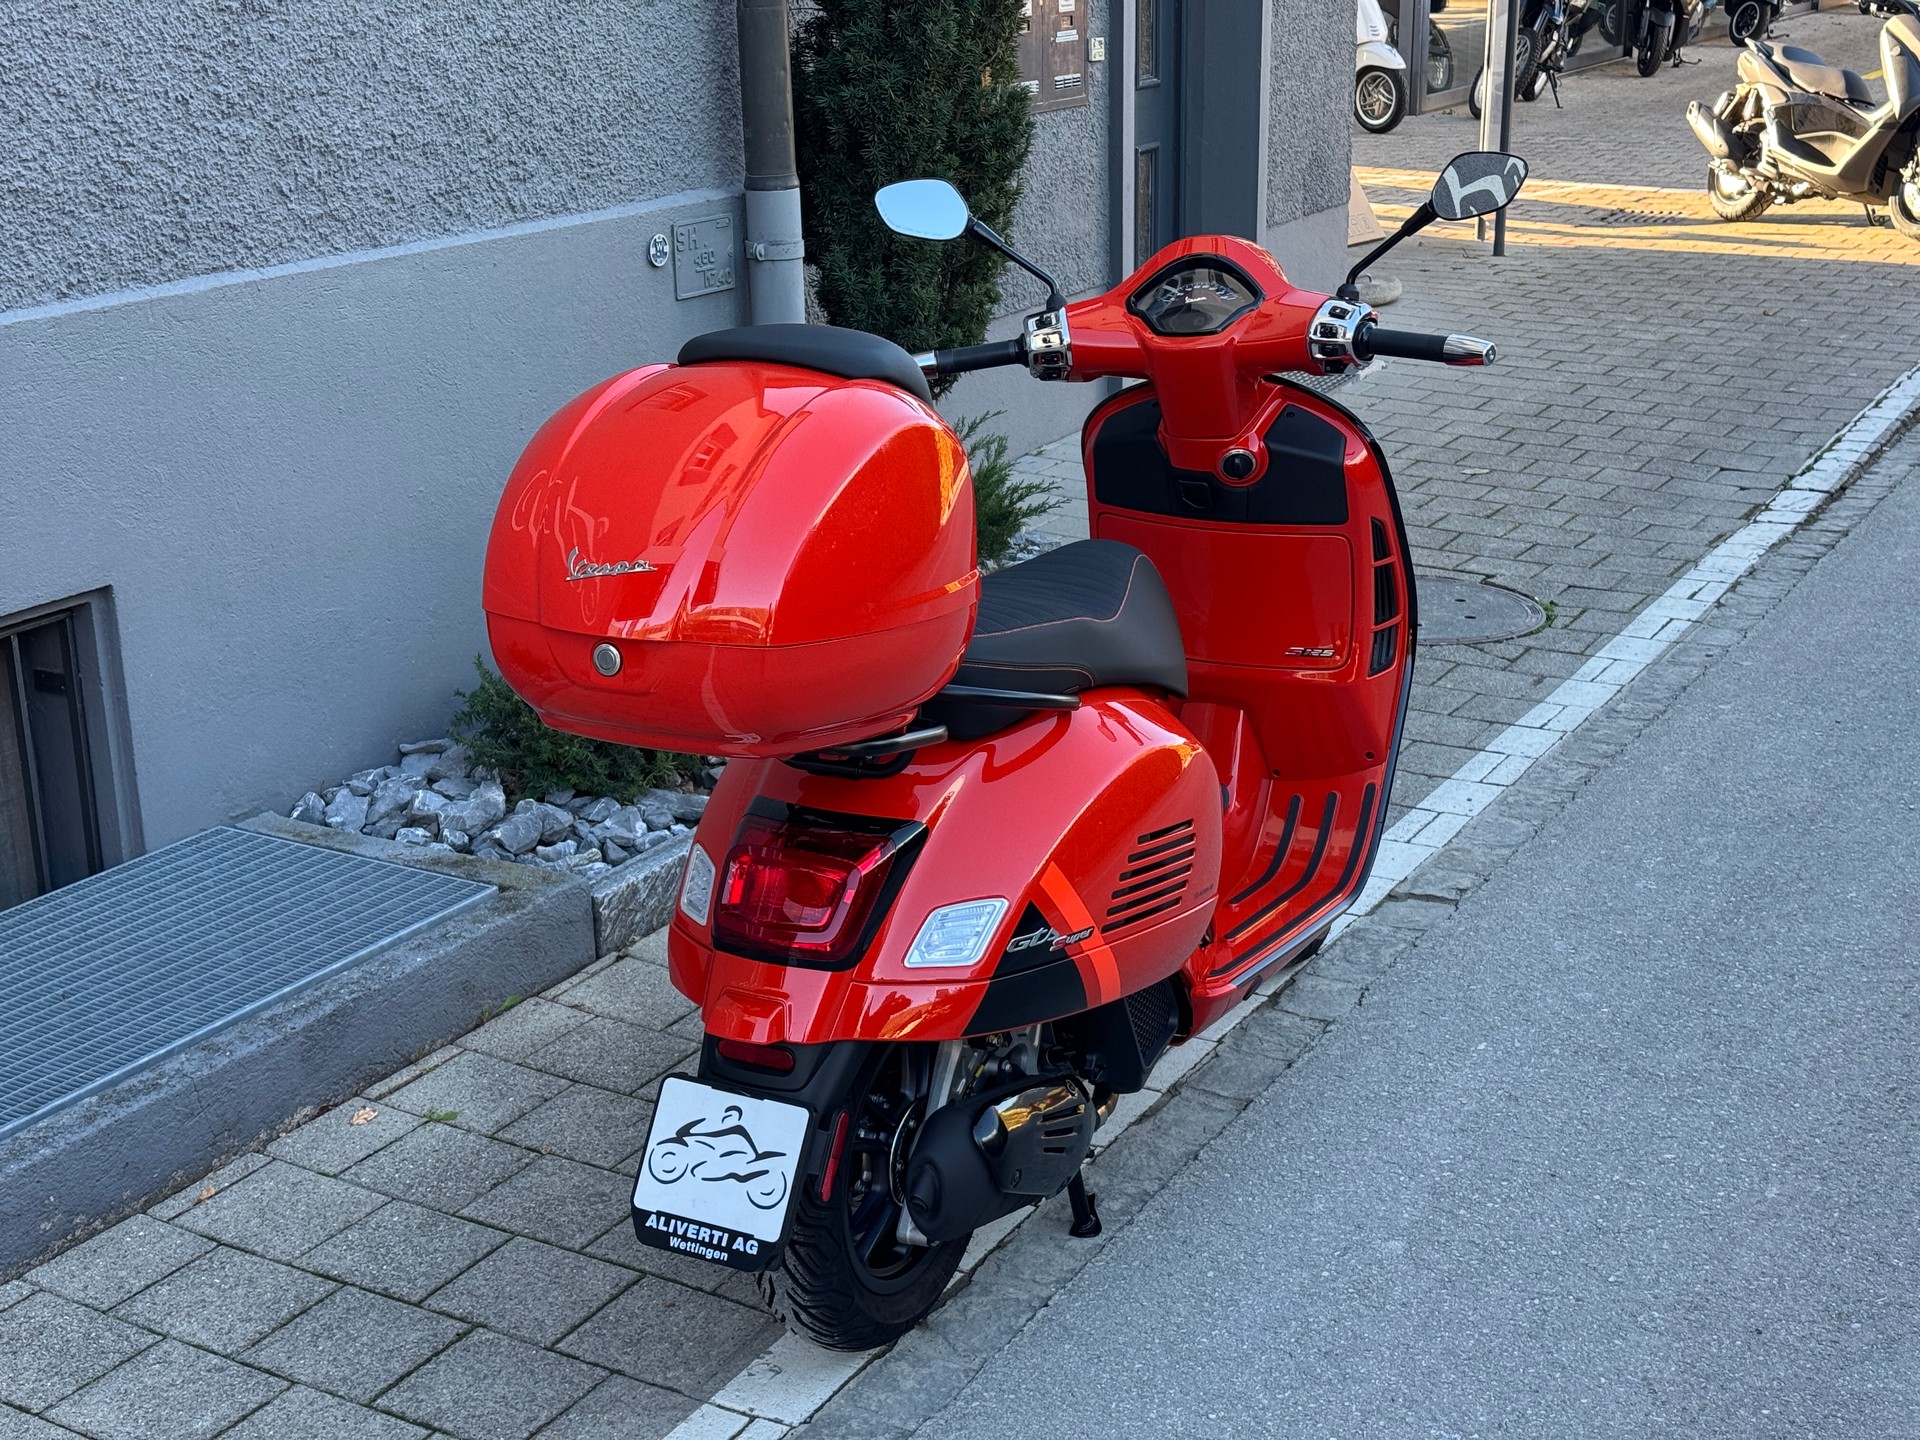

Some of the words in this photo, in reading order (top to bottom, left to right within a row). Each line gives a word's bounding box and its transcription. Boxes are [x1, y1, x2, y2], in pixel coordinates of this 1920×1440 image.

[565, 546, 658, 581] Vespa
[1049, 927, 1094, 952] Super
[645, 1214, 729, 1247] ALIVERTI
[732, 1236, 759, 1255] AG
[669, 1236, 728, 1261] Wettingen
